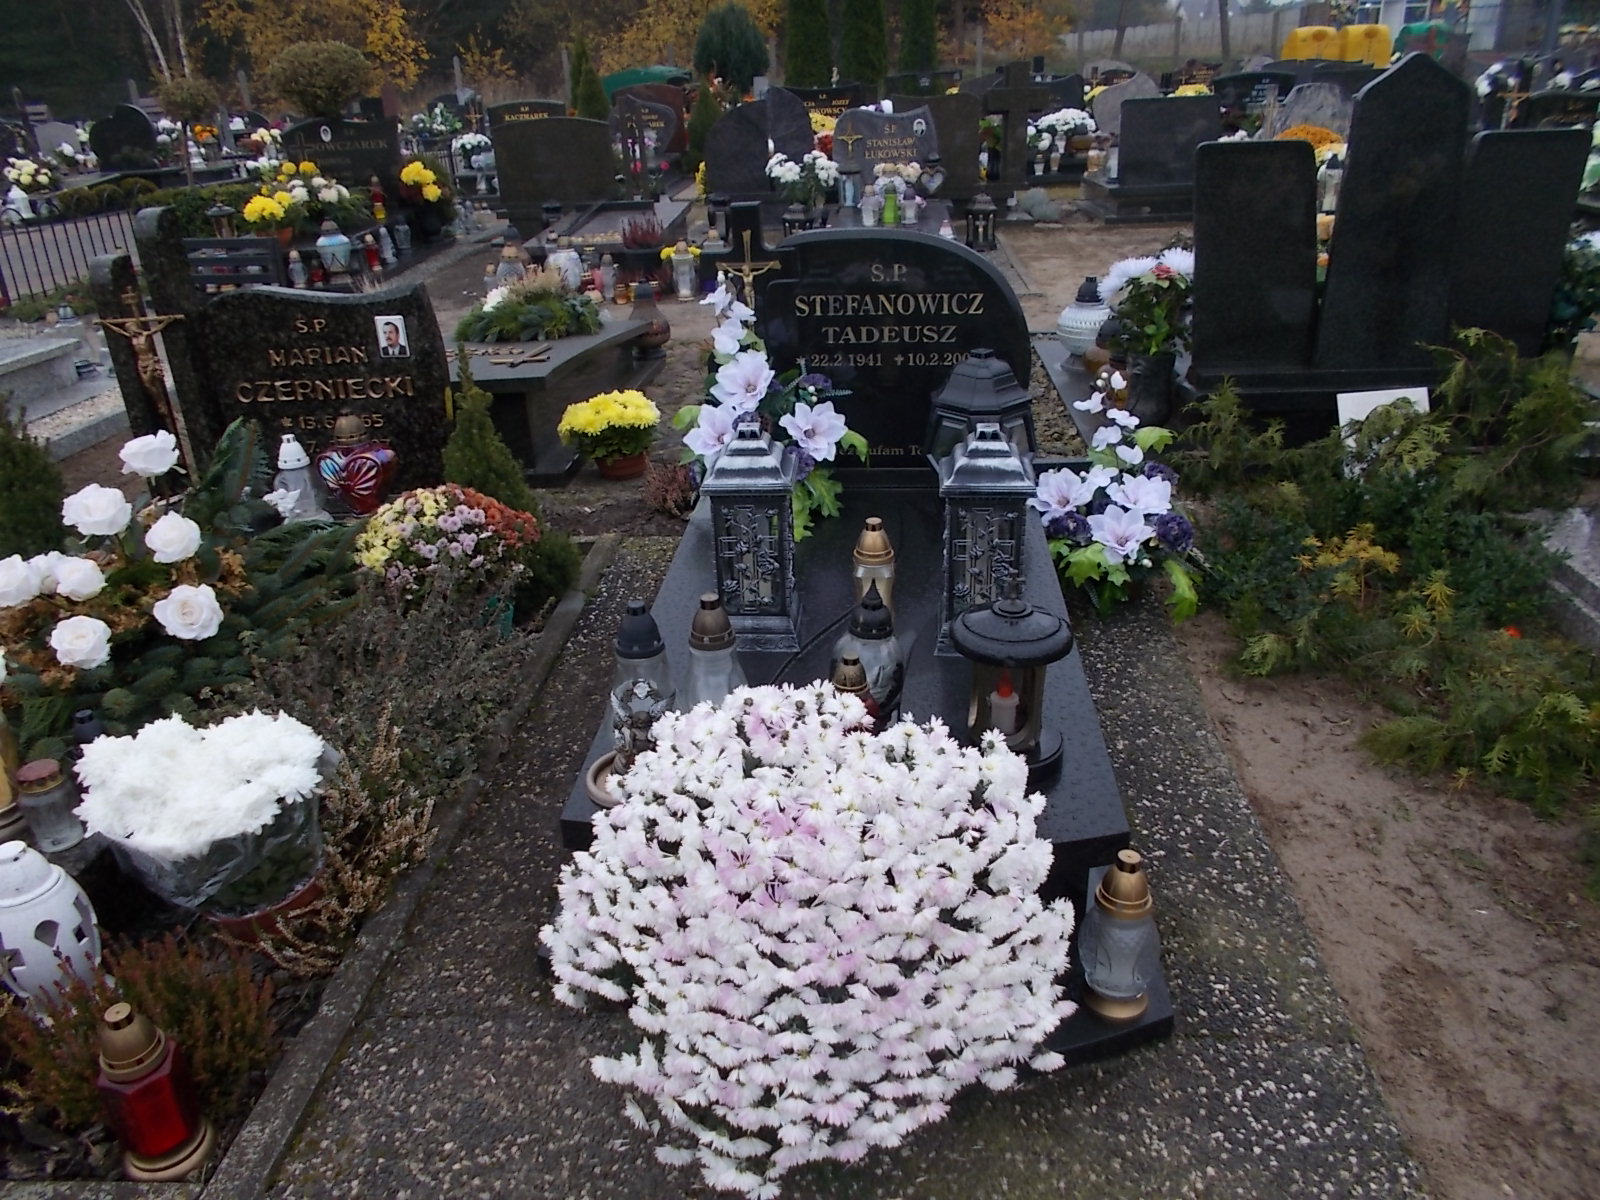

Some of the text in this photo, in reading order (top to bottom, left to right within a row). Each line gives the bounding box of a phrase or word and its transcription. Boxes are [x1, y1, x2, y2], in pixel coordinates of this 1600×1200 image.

[794, 292, 984, 317] STEFANOWICZ
[822, 325, 957, 344] TADEUSZ
[267, 345, 369, 367] MARIAN
[907, 352, 971, 366] 10.2.200
[236, 376, 415, 404] CZERNIECKI
[868, 444, 904, 456] ufam
